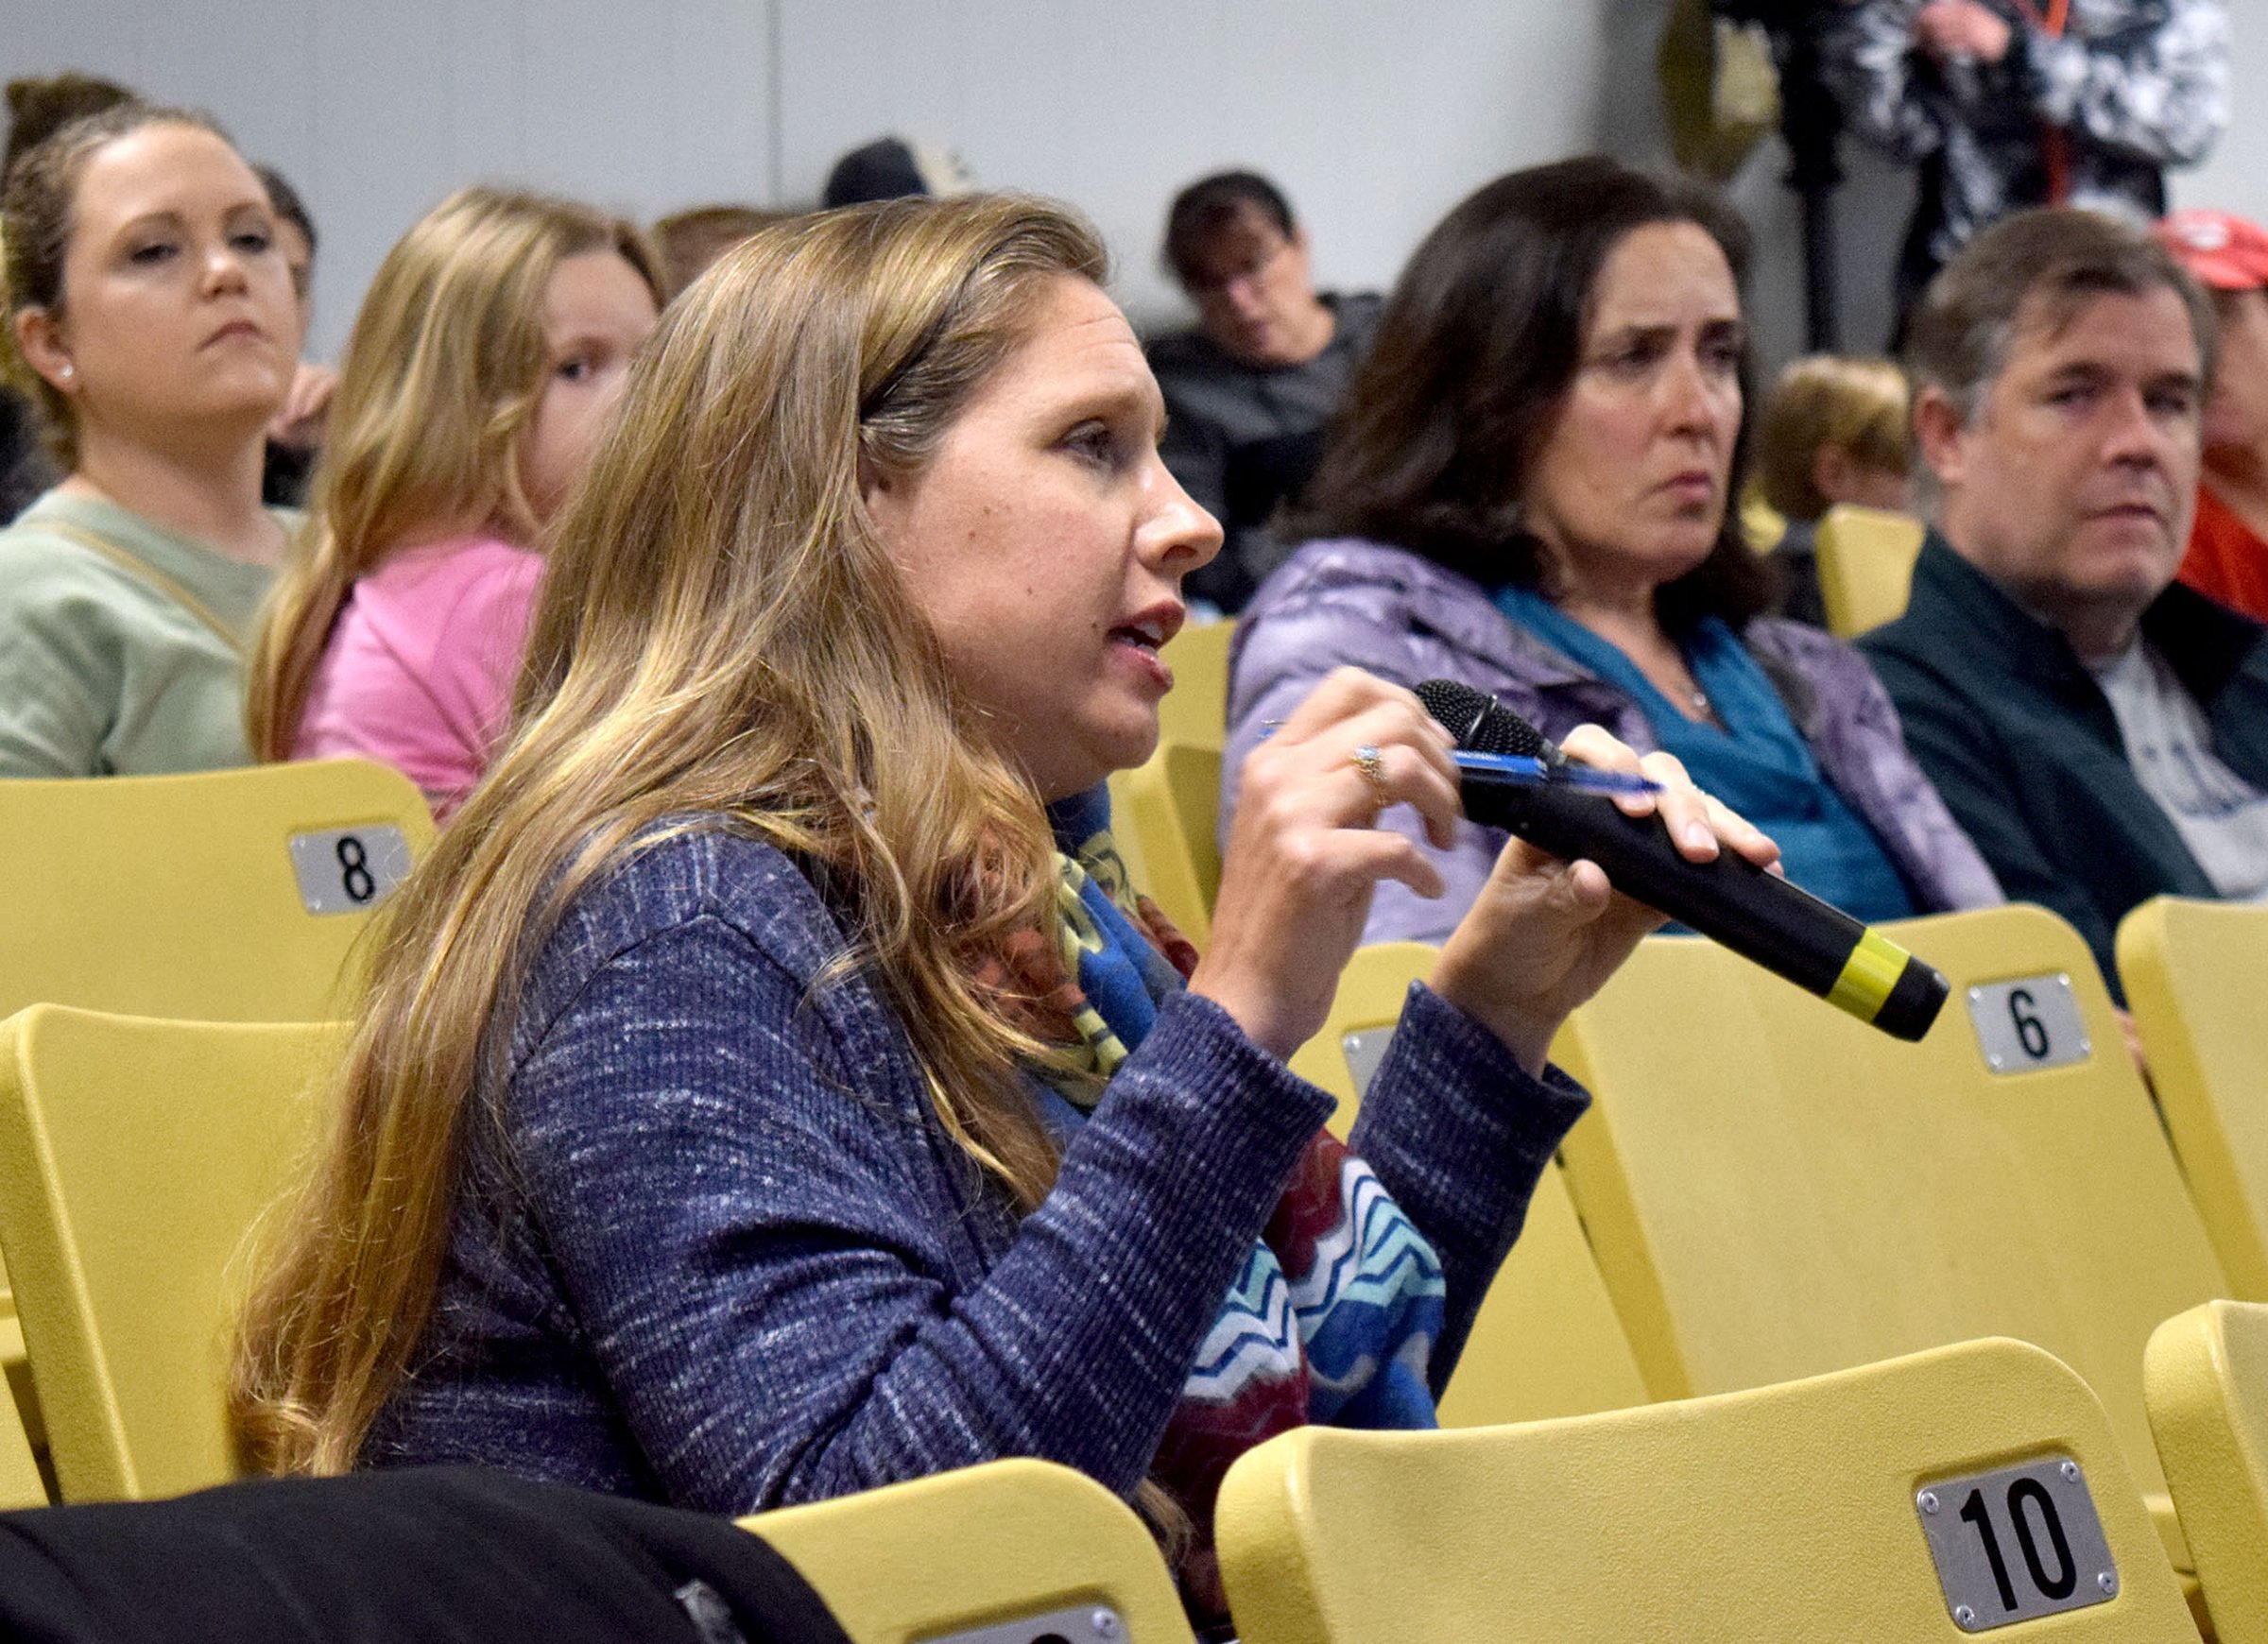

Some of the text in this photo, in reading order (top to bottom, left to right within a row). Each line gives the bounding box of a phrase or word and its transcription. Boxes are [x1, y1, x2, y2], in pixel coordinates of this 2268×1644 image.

[336, 836, 375, 904] 8
[2009, 989, 2049, 1059] 6
[1960, 1478, 2077, 1612] 10
